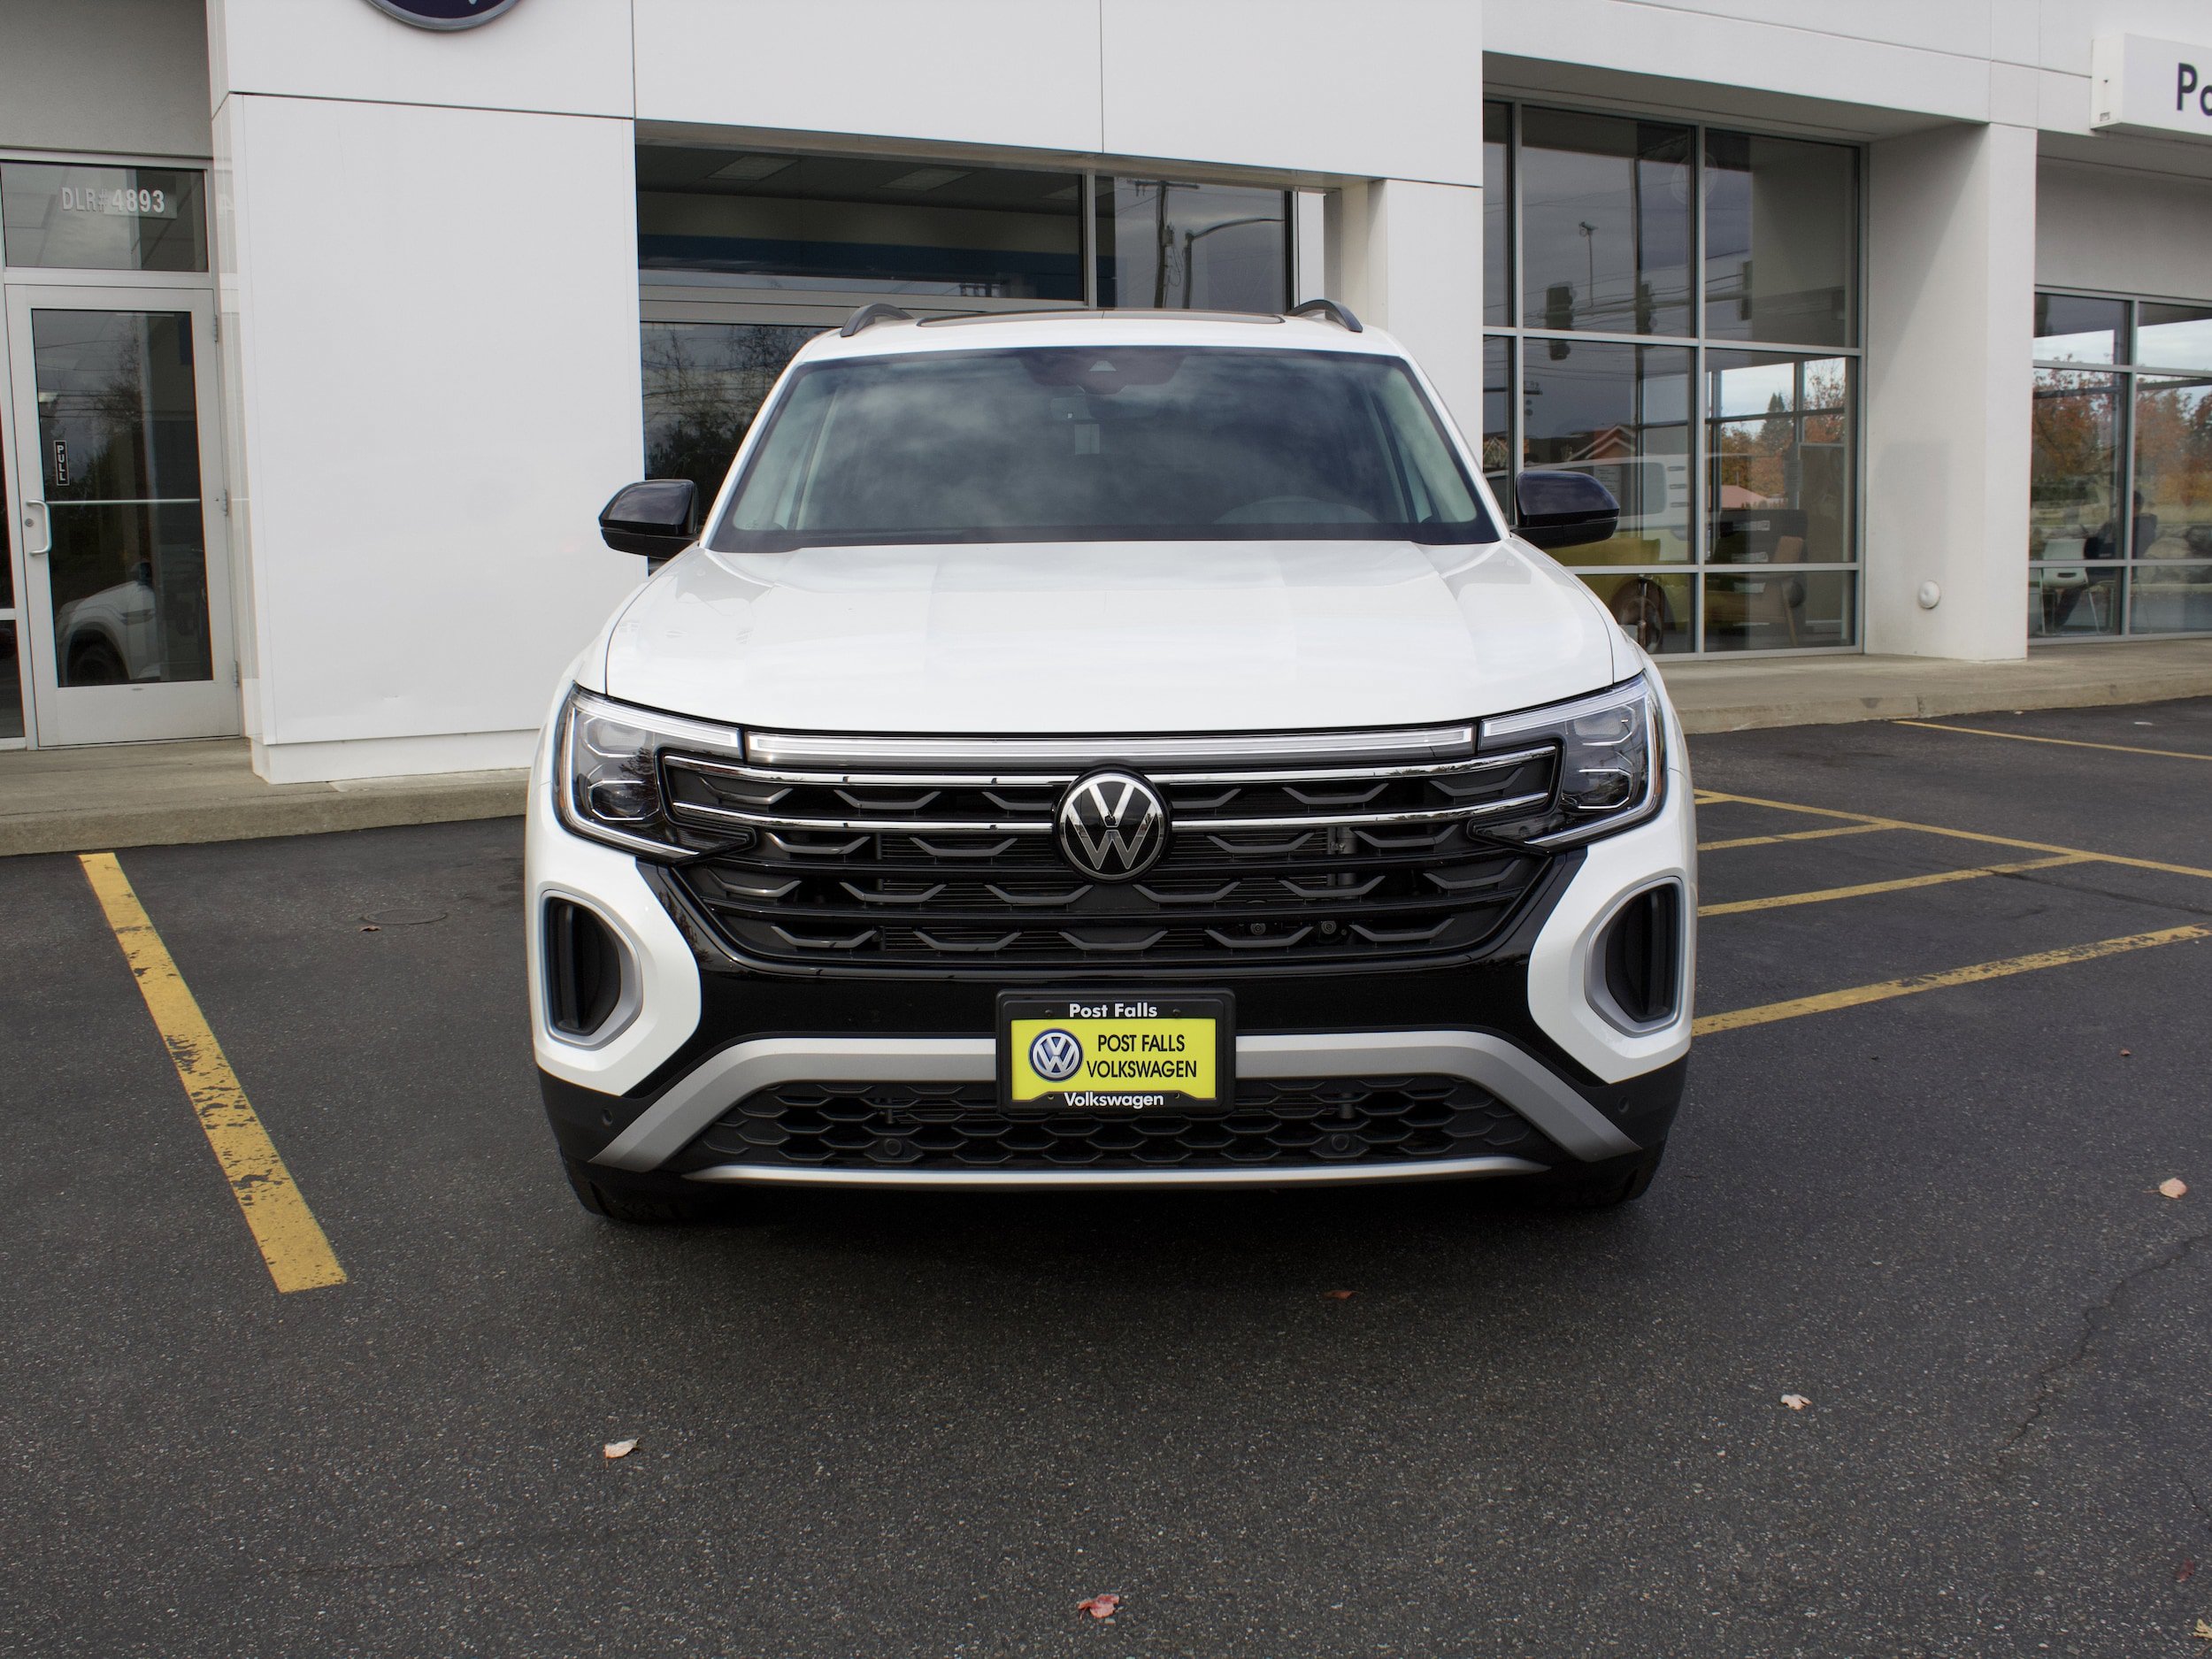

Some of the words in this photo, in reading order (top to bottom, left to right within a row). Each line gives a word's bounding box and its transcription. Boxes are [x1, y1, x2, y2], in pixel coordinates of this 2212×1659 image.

[57, 444, 66, 481] PULL
[1069, 1002, 1108, 1018] Post
[1114, 1002, 1157, 1018] Falls
[1098, 1034, 1137, 1052] POST
[1142, 1034, 1185, 1052] FALLS
[1087, 1060, 1196, 1078] VOLKSWAGEN
[1064, 1092, 1164, 1109] Volkswagen
